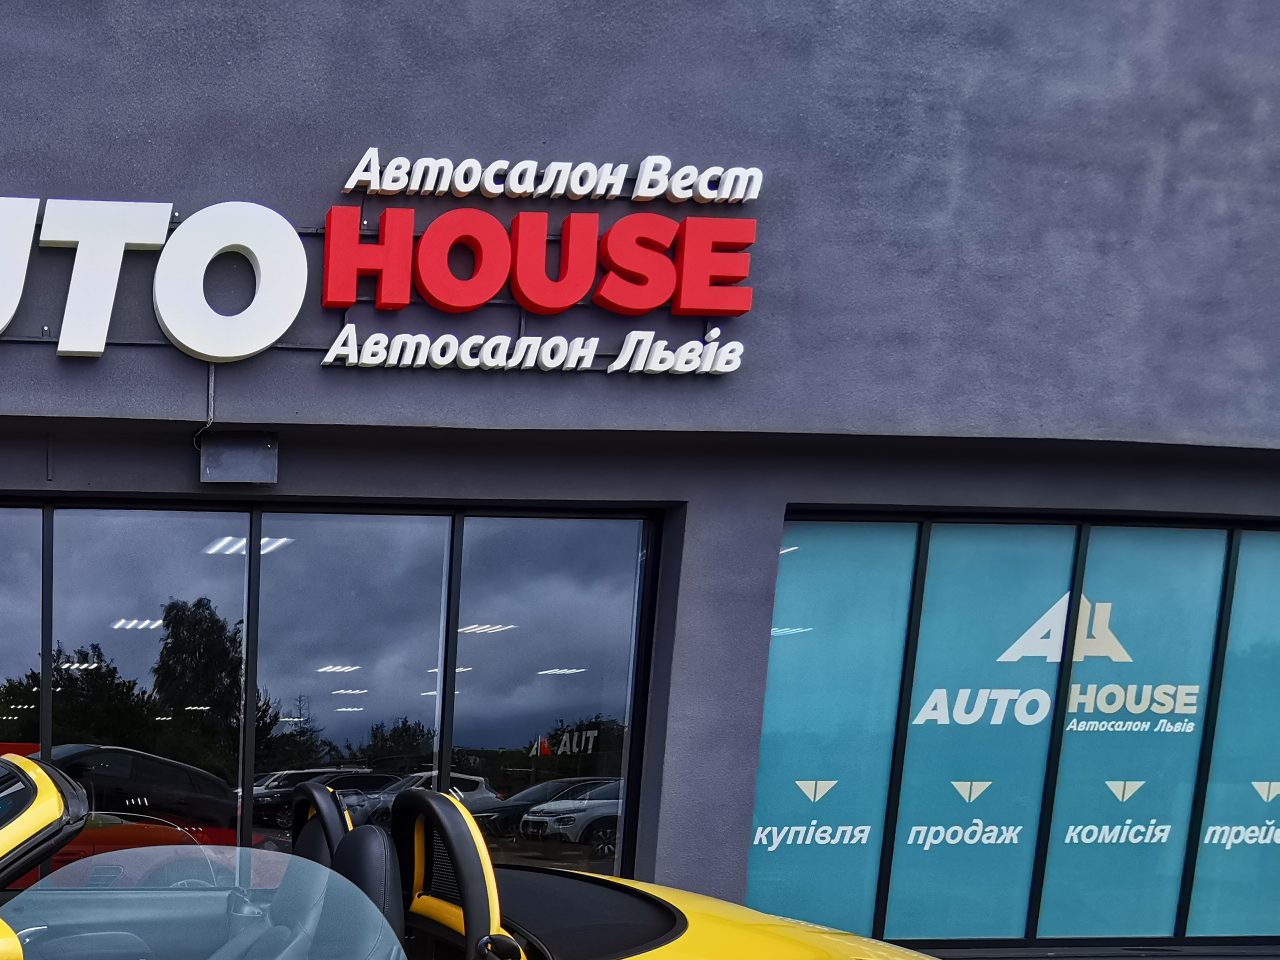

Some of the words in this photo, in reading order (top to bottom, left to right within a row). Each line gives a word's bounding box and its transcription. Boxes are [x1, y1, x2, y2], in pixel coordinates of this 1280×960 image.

[341, 147, 629, 198] Автосалон
[631, 155, 763, 203] Вест
[323, 206, 757, 316] HOUSE
[322, 324, 600, 371] Автосалон
[608, 327, 745, 375] Львів
[912, 688, 1051, 726] AUTO
[1067, 683, 1200, 715] HOUSE
[1066, 717, 1150, 733] Автосалон
[1154, 718, 1195, 733] Львів
[753, 821, 870, 851] купівля
[907, 821, 1023, 850] продаж
[1064, 821, 1171, 844] комісія
